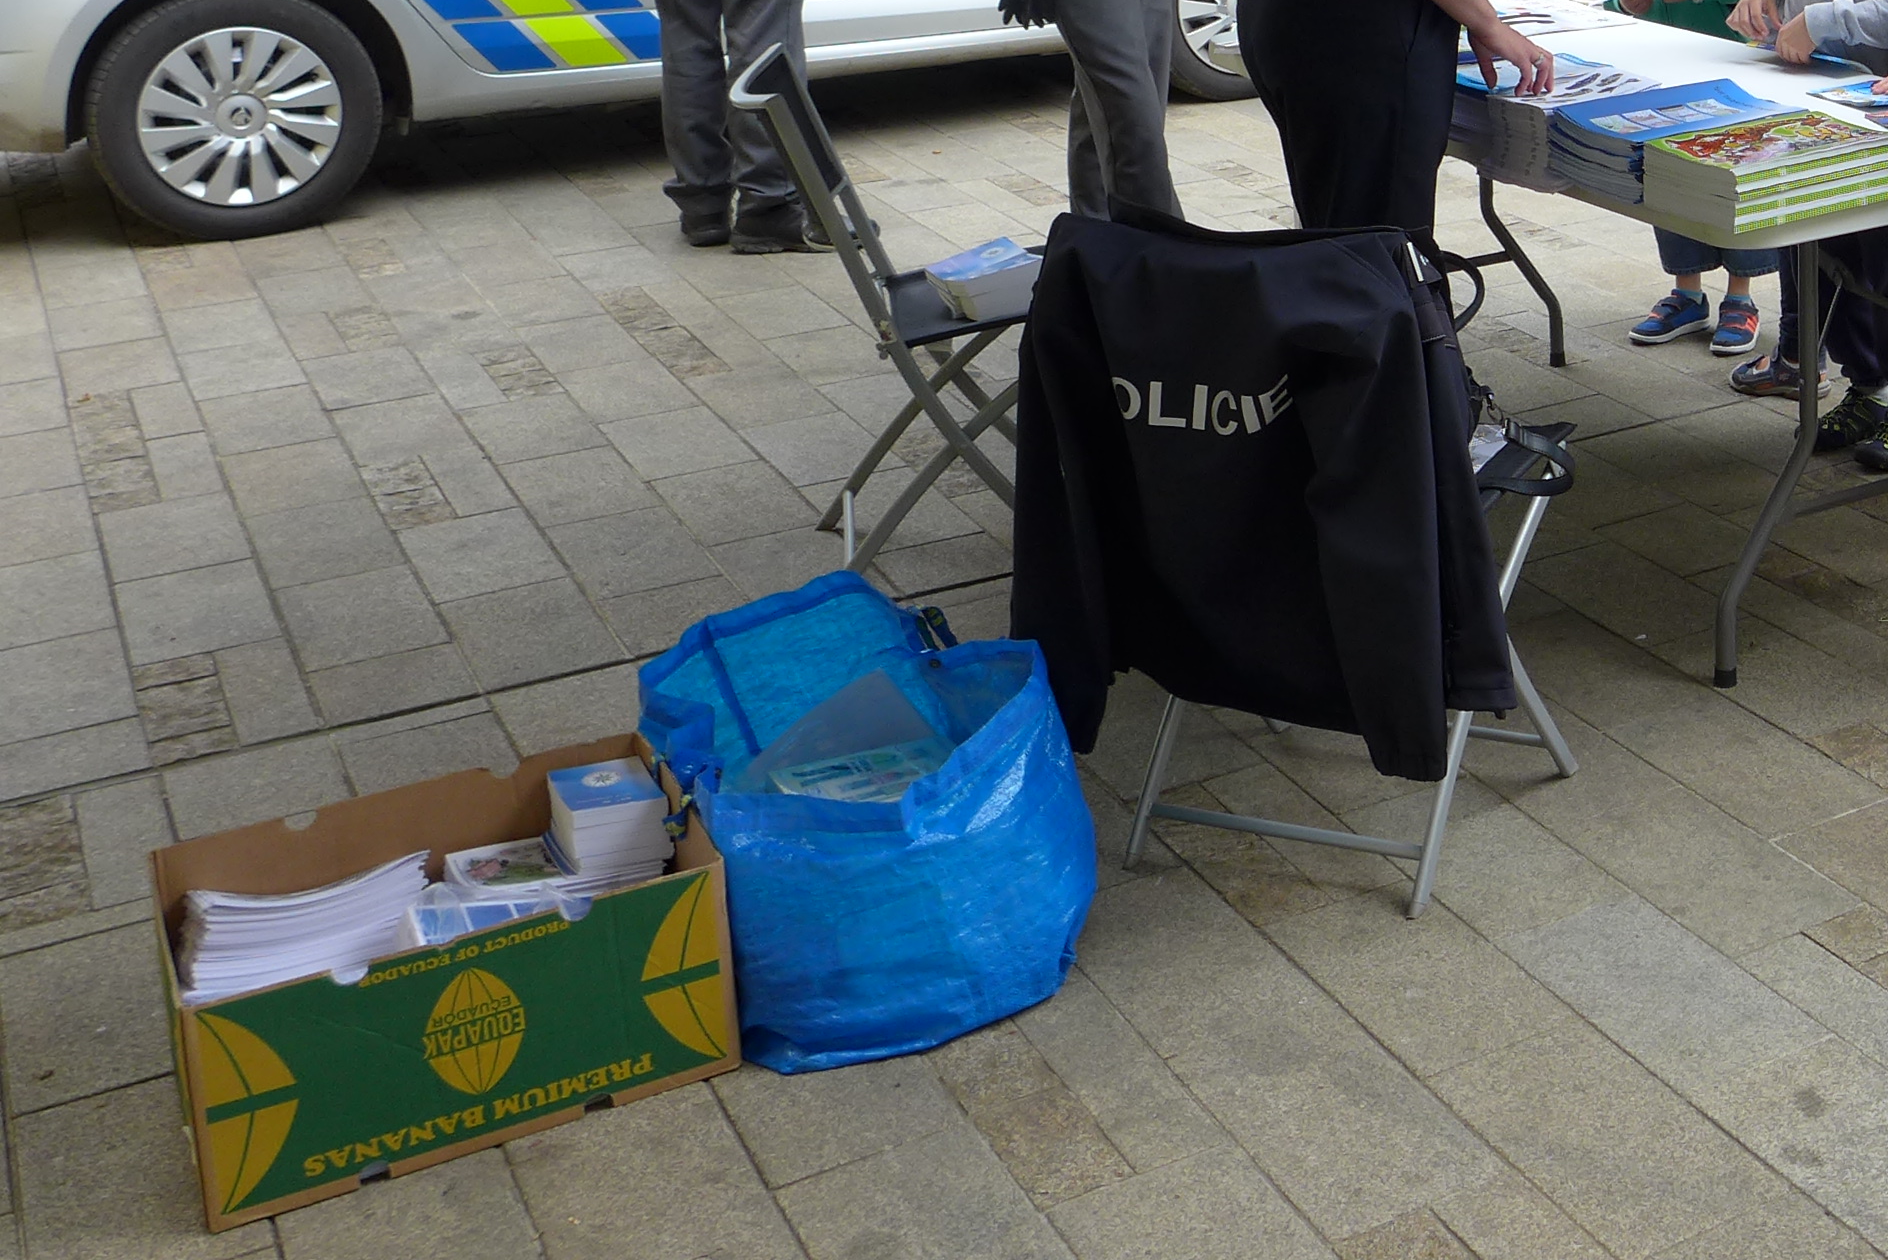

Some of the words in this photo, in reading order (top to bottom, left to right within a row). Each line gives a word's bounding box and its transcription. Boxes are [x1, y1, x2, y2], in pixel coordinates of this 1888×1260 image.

[1112, 373, 1294, 436] OLICIE
[455, 944, 480, 961] OF
[483, 921, 570, 953] PRODUCT
[421, 1006, 526, 1059] EQUAPAK
[432, 995, 512, 1028] ECUADOR
[494, 1052, 654, 1120] PREMIUM
[304, 1104, 487, 1178] BANANAS
